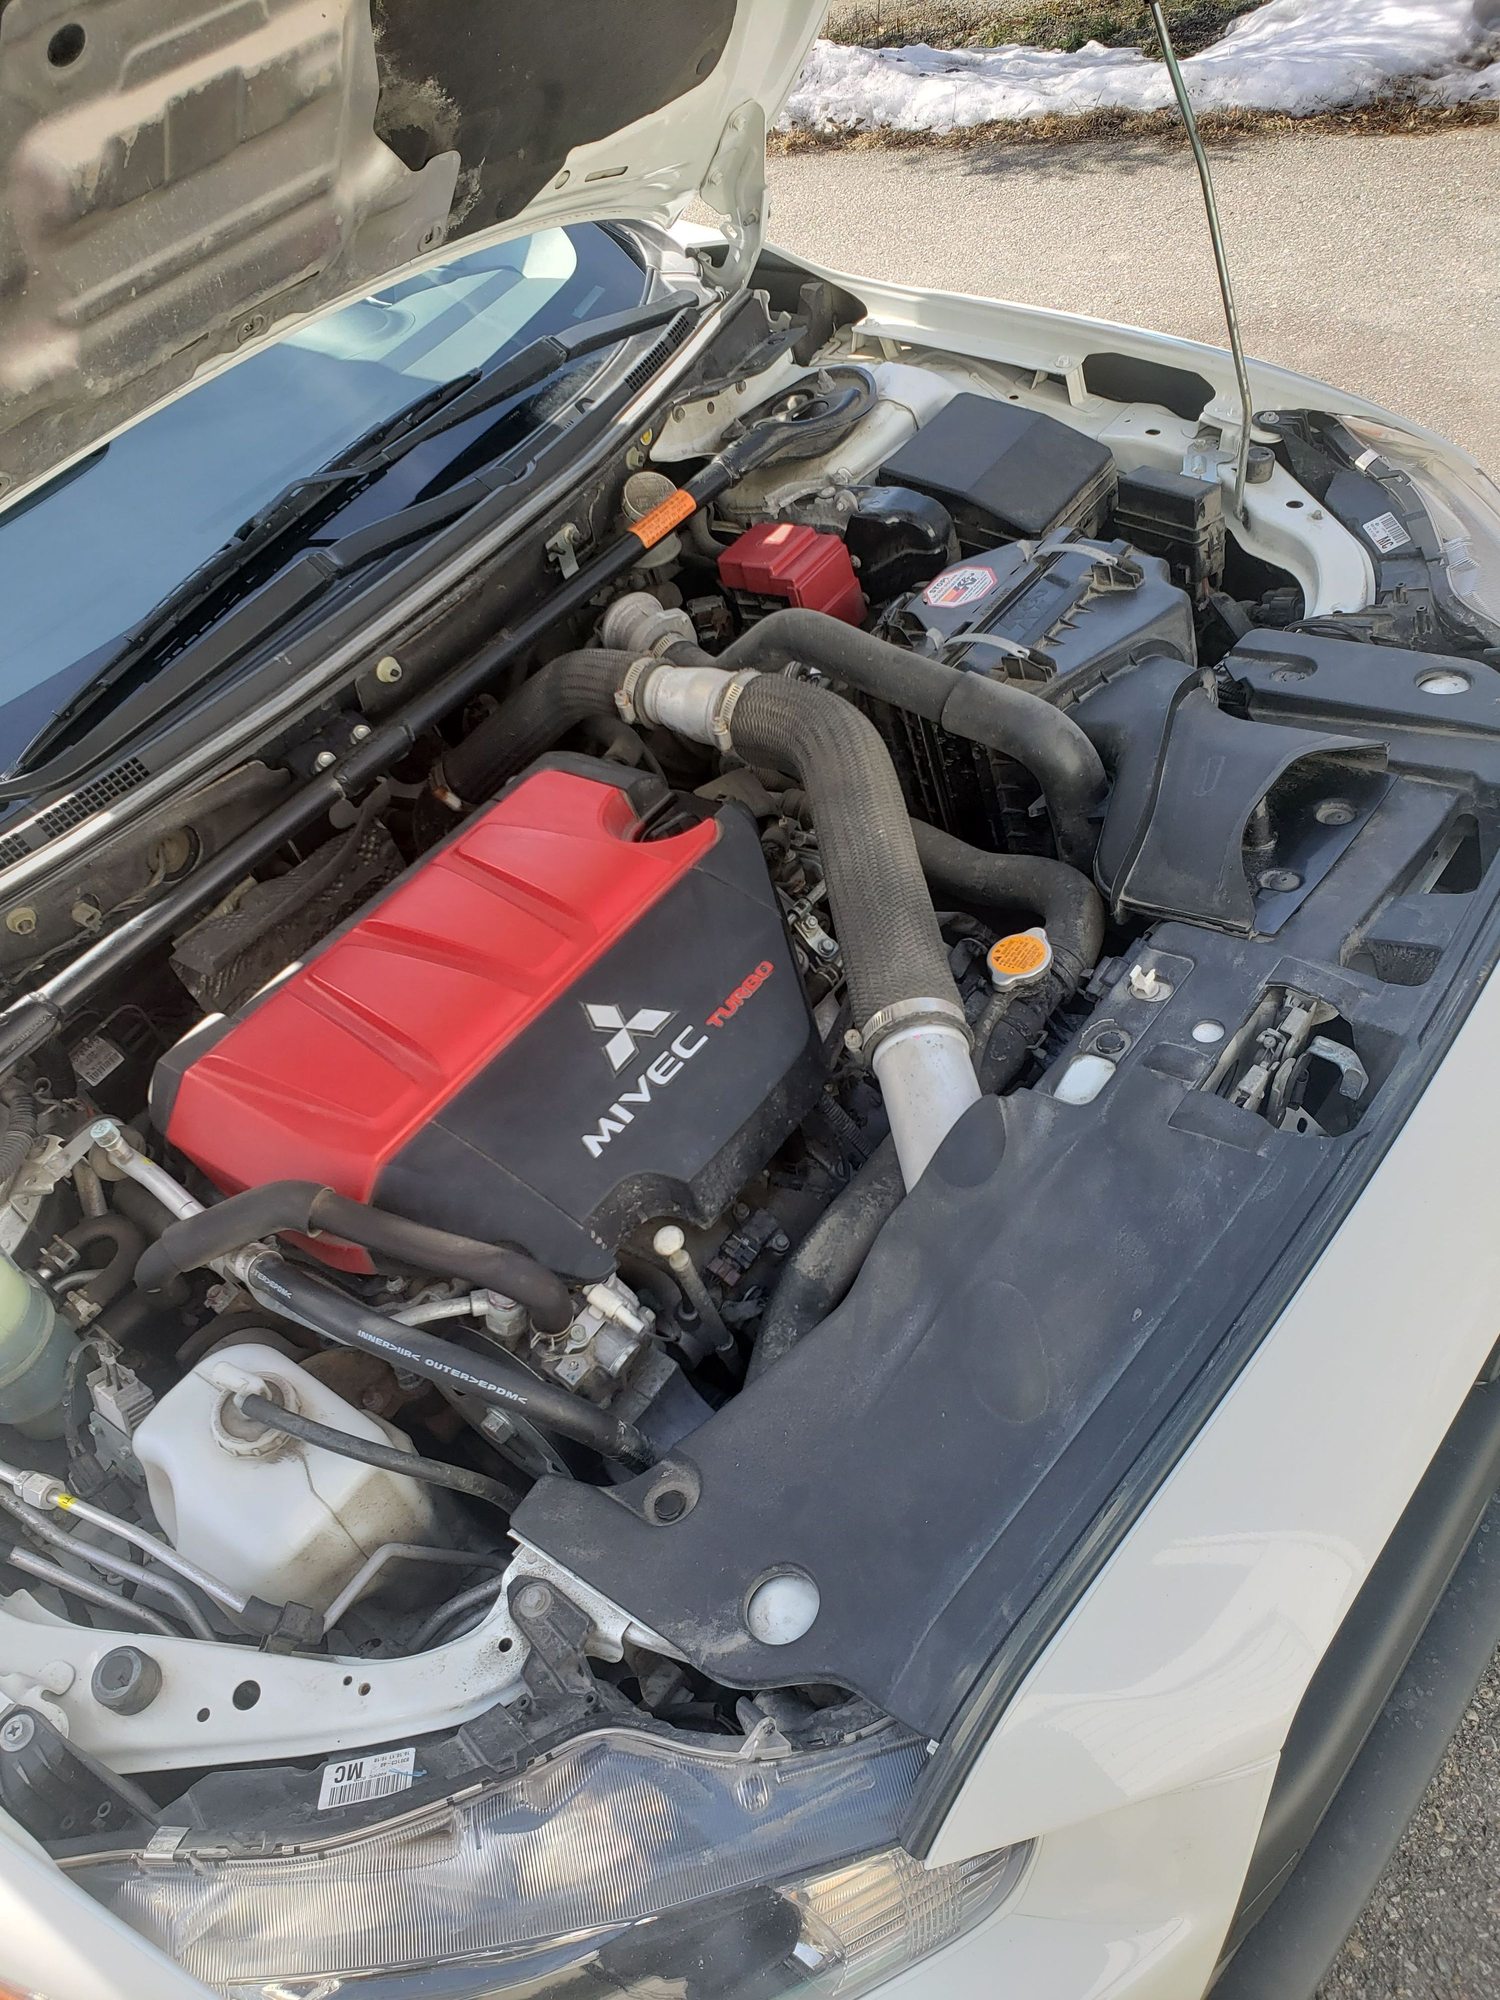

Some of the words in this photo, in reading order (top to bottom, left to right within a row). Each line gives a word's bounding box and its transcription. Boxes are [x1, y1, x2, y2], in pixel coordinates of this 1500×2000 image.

[582, 1025, 709, 1159] MIVEC
[705, 960, 775, 1028] TURBO
[334, 1761, 364, 1784] MC
